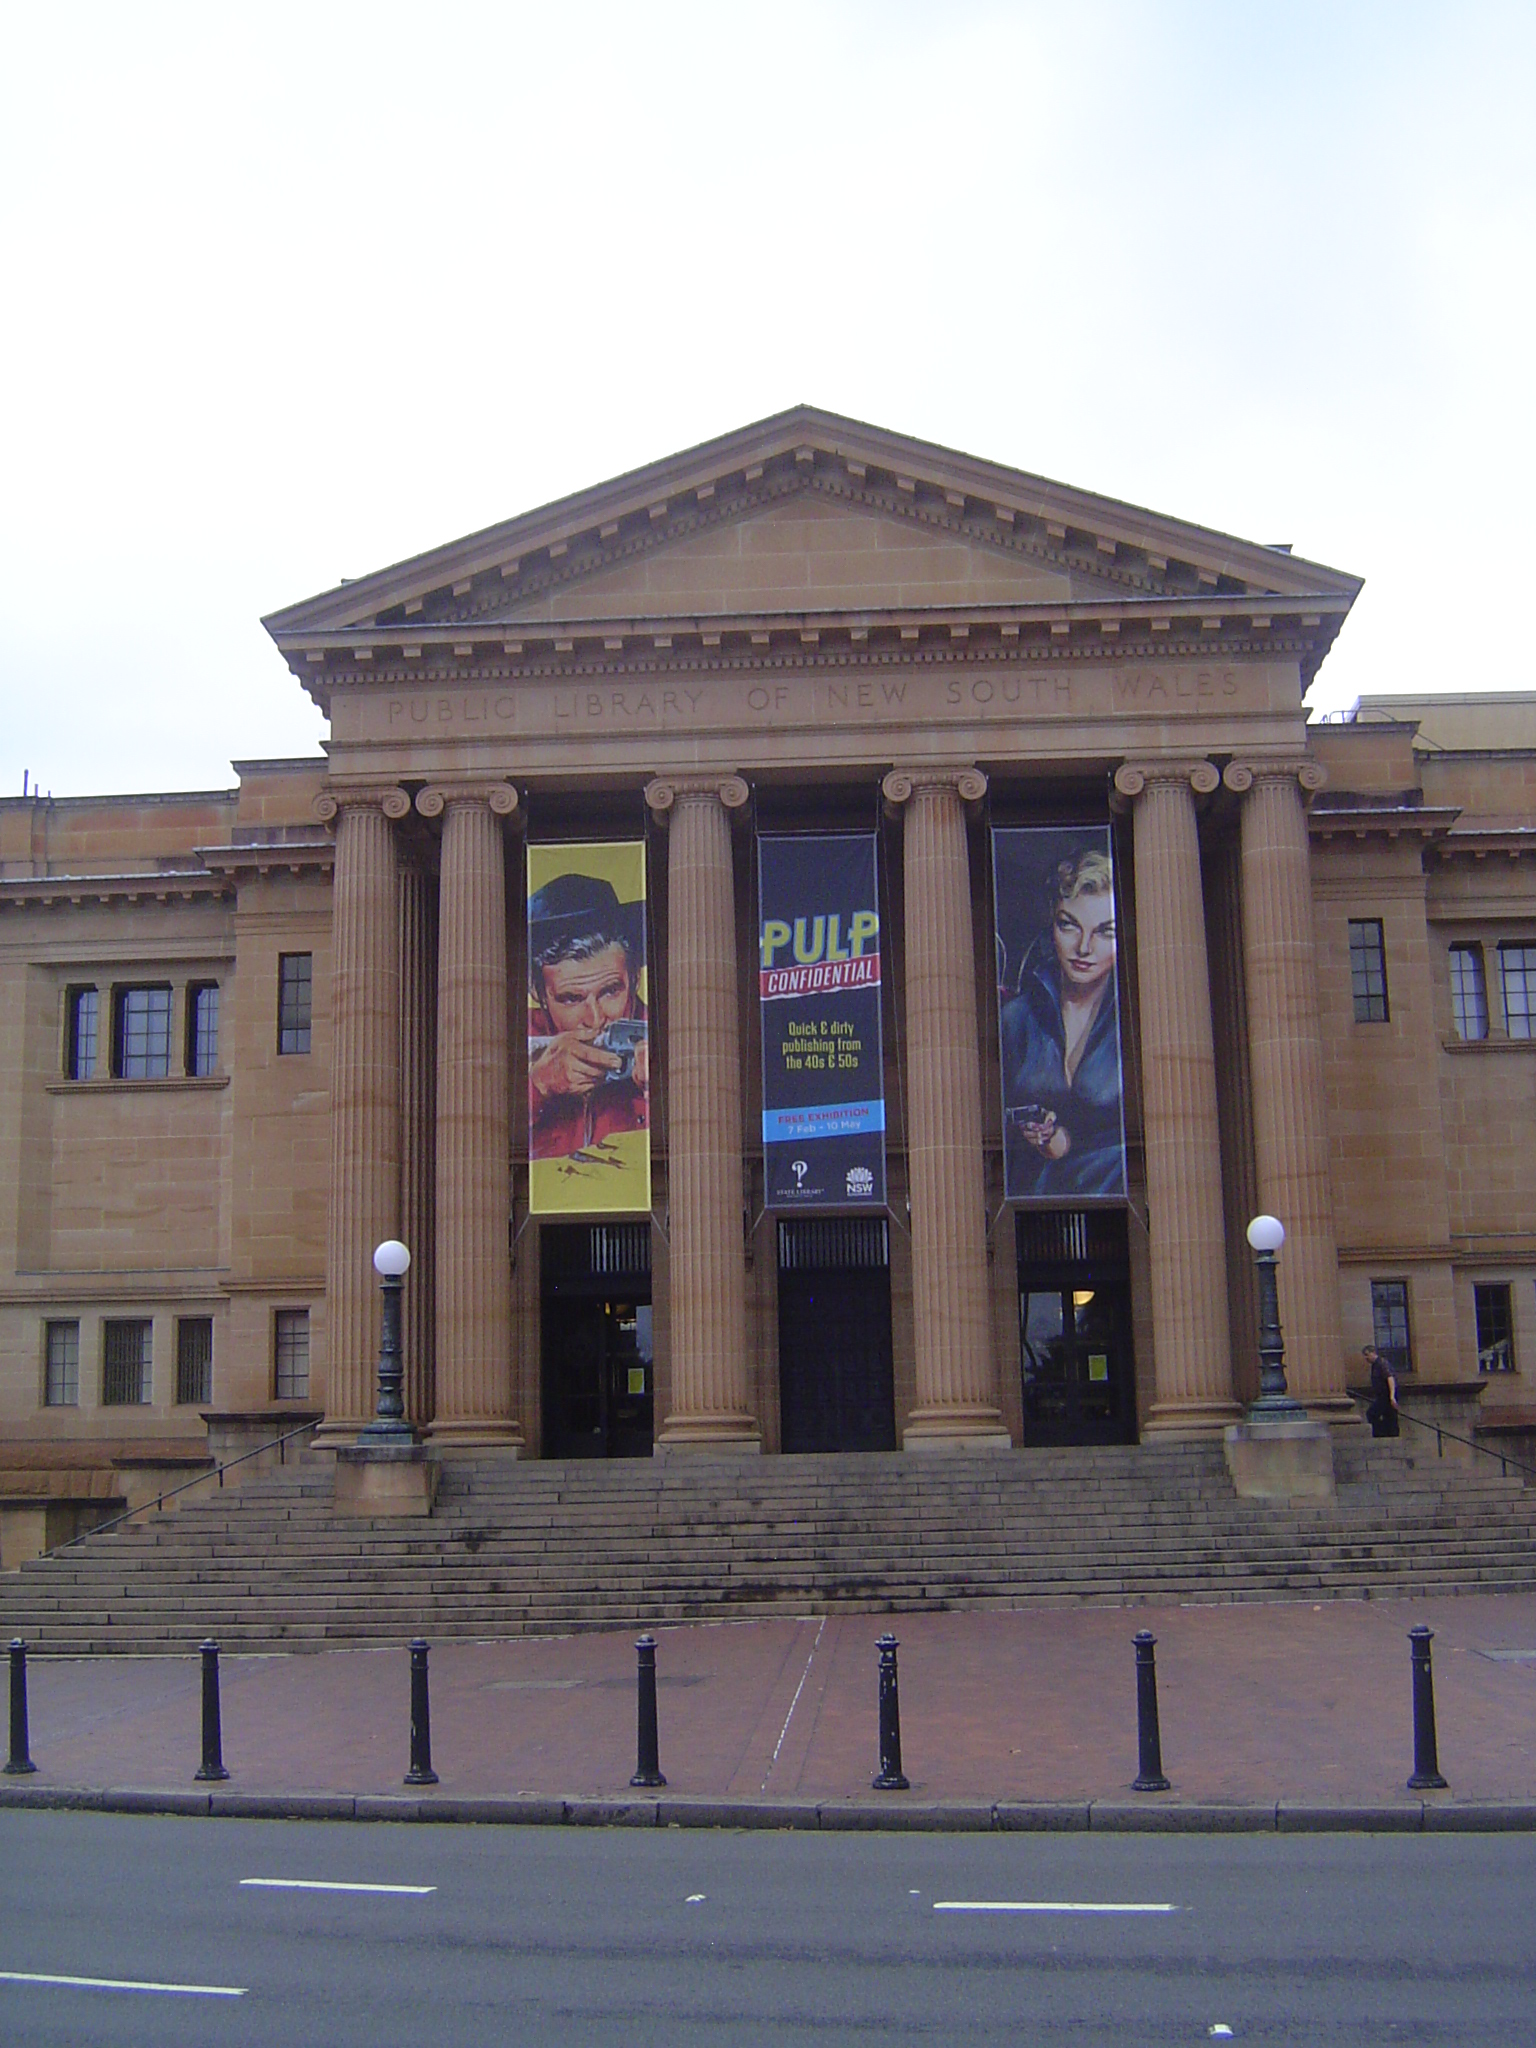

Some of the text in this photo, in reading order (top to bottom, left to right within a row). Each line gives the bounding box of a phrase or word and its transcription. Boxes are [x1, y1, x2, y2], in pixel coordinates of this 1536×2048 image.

[388, 672, 1238, 724] PUBLIC LIBRARY OF NEW SOUTH WALES
[760, 910, 879, 968] PULP
[768, 960, 872, 993] CONFIDENTIAL
[788, 1021, 818, 1036] Quick
[830, 1021, 855, 1037] dirty
[782, 1037, 862, 1056] publishing from
[786, 1055, 802, 1069] the
[804, 1054, 825, 1069] 40s
[838, 1053, 858, 1068] 50s
[778, 1108, 869, 1124] FREE EXHIBITION
[788, 1125, 794, 1134] 7
[797, 1124, 816, 1133] Feb
[827, 1122, 838, 1130] 10
[841, 1120, 861, 1129] May
[847, 1183, 872, 1193] NSW
